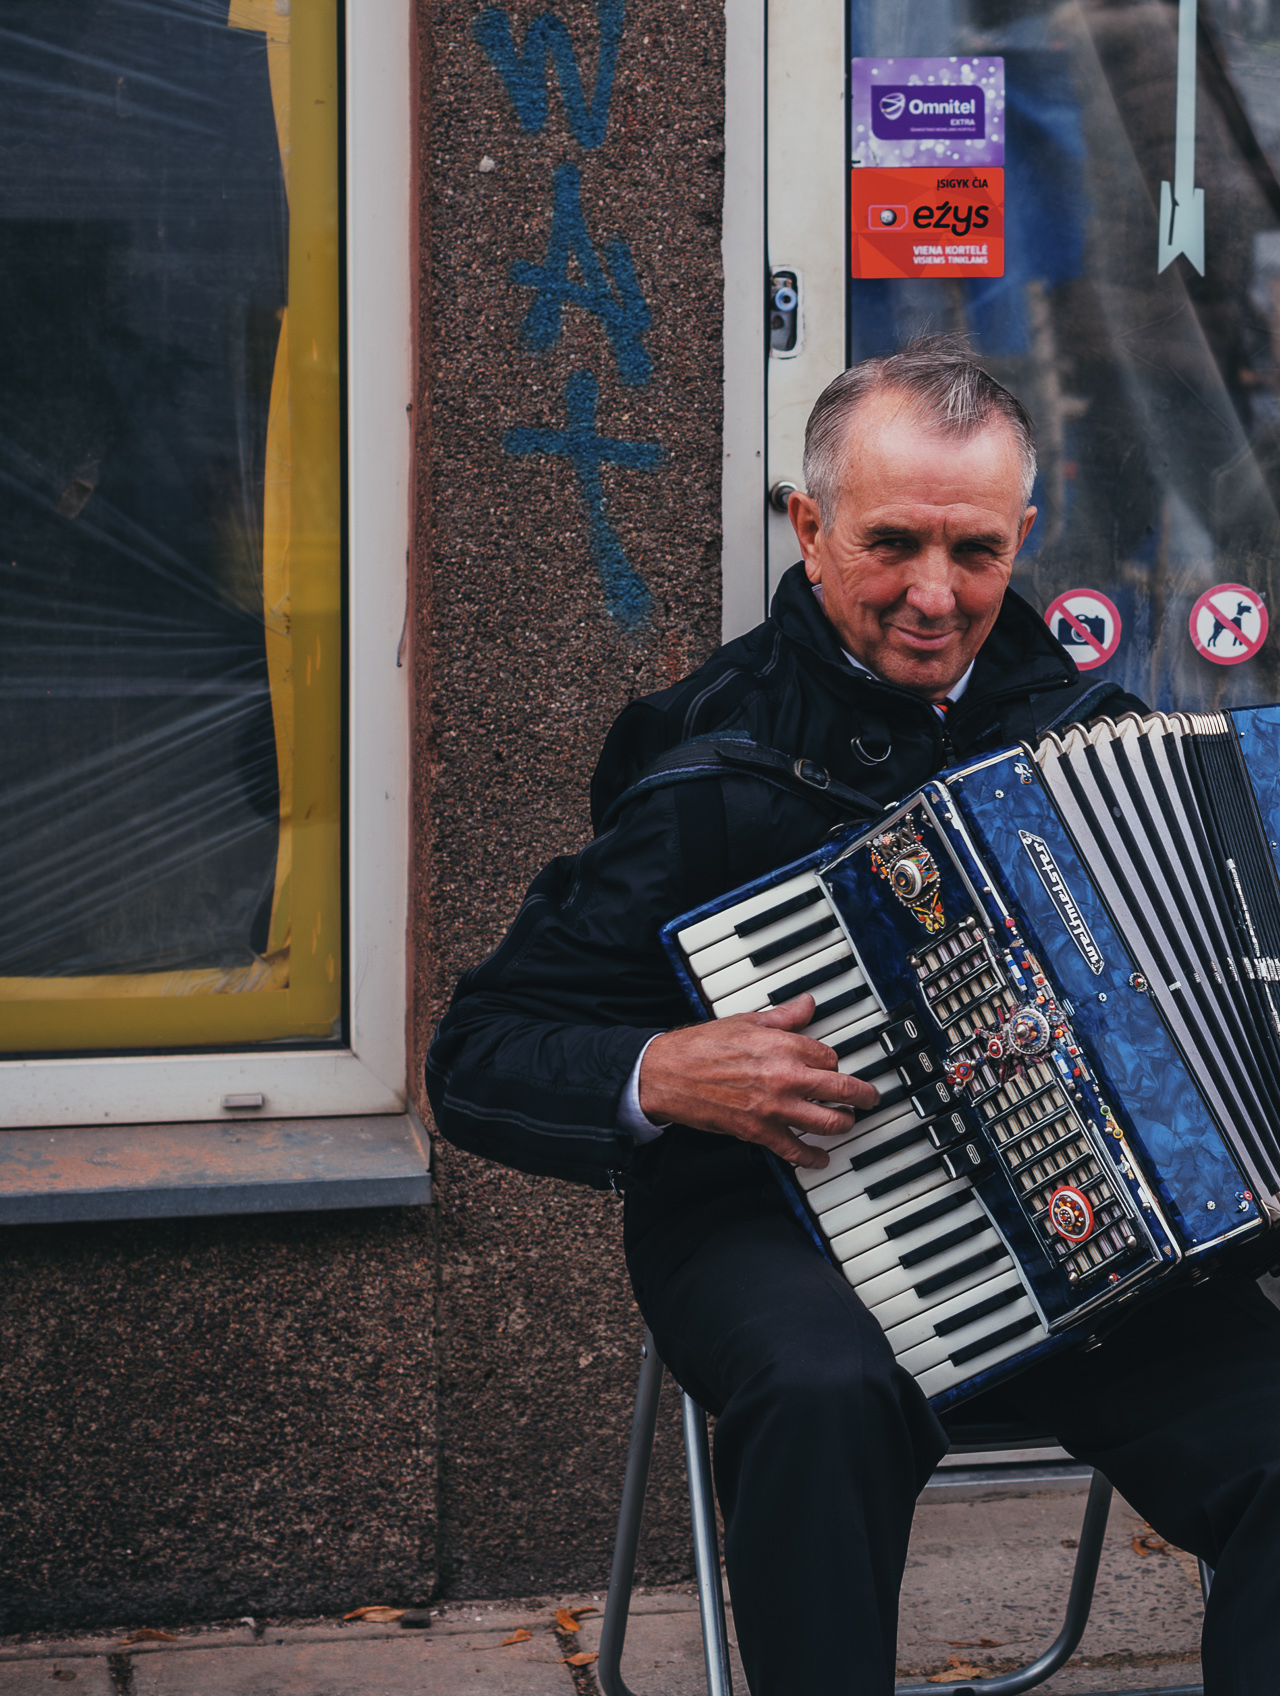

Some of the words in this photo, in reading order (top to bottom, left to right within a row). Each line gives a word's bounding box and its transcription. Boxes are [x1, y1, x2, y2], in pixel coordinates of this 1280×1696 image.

[908, 99, 976, 115] Omnitel
[950, 118, 976, 126] EXTRA
[936, 179, 970, 191] ĮSIGYK
[972, 176, 989, 188] ČIA
[912, 245, 943, 255] VIENA
[912, 256, 946, 265] VISIEMS
[947, 256, 989, 265] TINKLAMS
